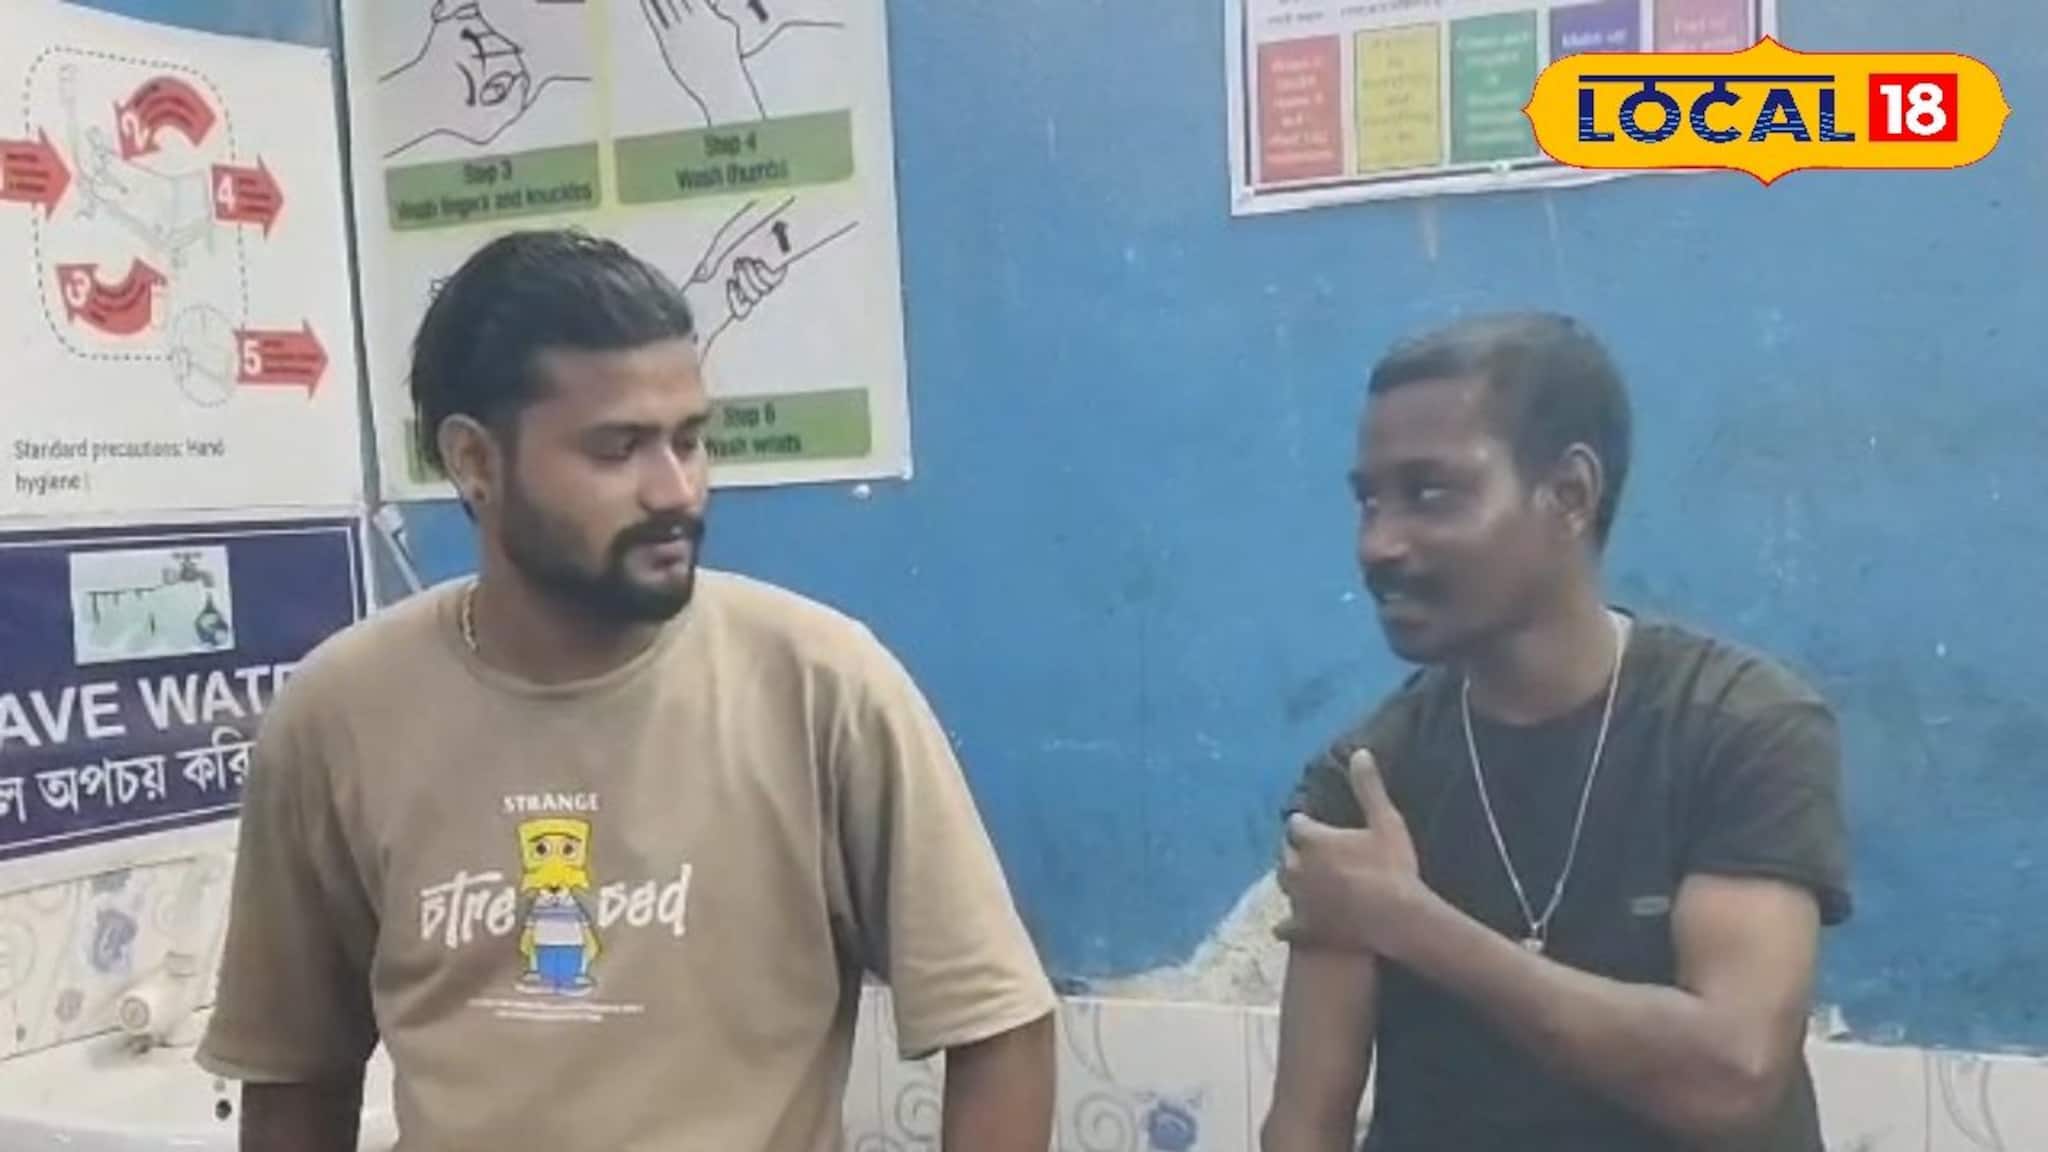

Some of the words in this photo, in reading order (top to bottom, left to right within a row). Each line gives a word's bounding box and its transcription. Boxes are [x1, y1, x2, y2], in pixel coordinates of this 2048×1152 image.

[218, 175, 237, 211] 4
[243, 340, 262, 374] 5
[14, 437, 88, 460] Standard
[15, 472, 81, 495] hygiene
[503, 793, 599, 812] STRANGE
